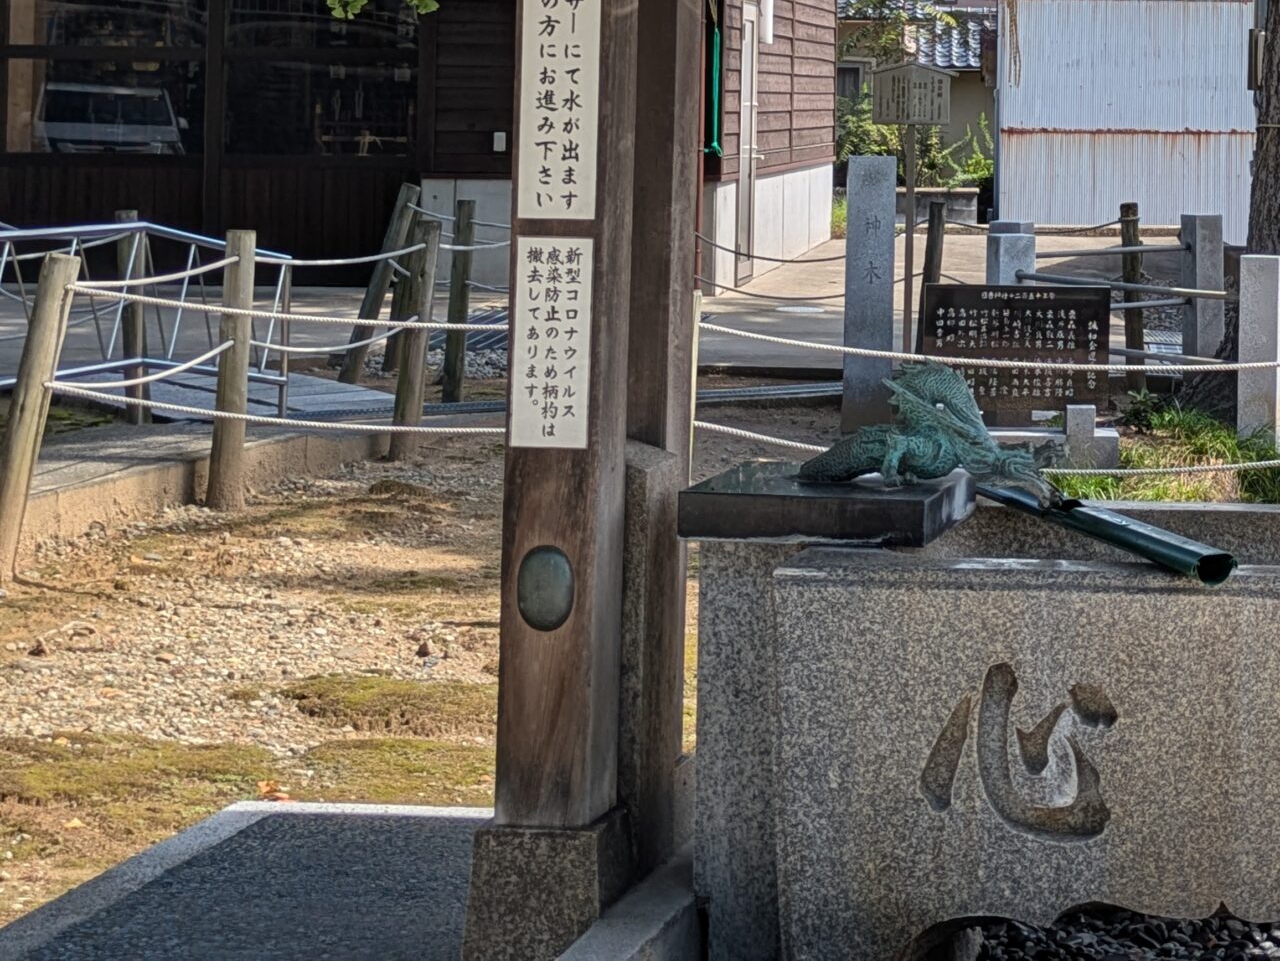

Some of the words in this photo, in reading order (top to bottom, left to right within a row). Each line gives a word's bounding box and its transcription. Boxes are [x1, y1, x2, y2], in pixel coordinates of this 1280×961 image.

[524, 246, 544, 407] 撤去してあります。
[541, 246, 564, 437] 感染防止のため柄杓は
[562, 246, 583, 418] 新型コロナウイルス
